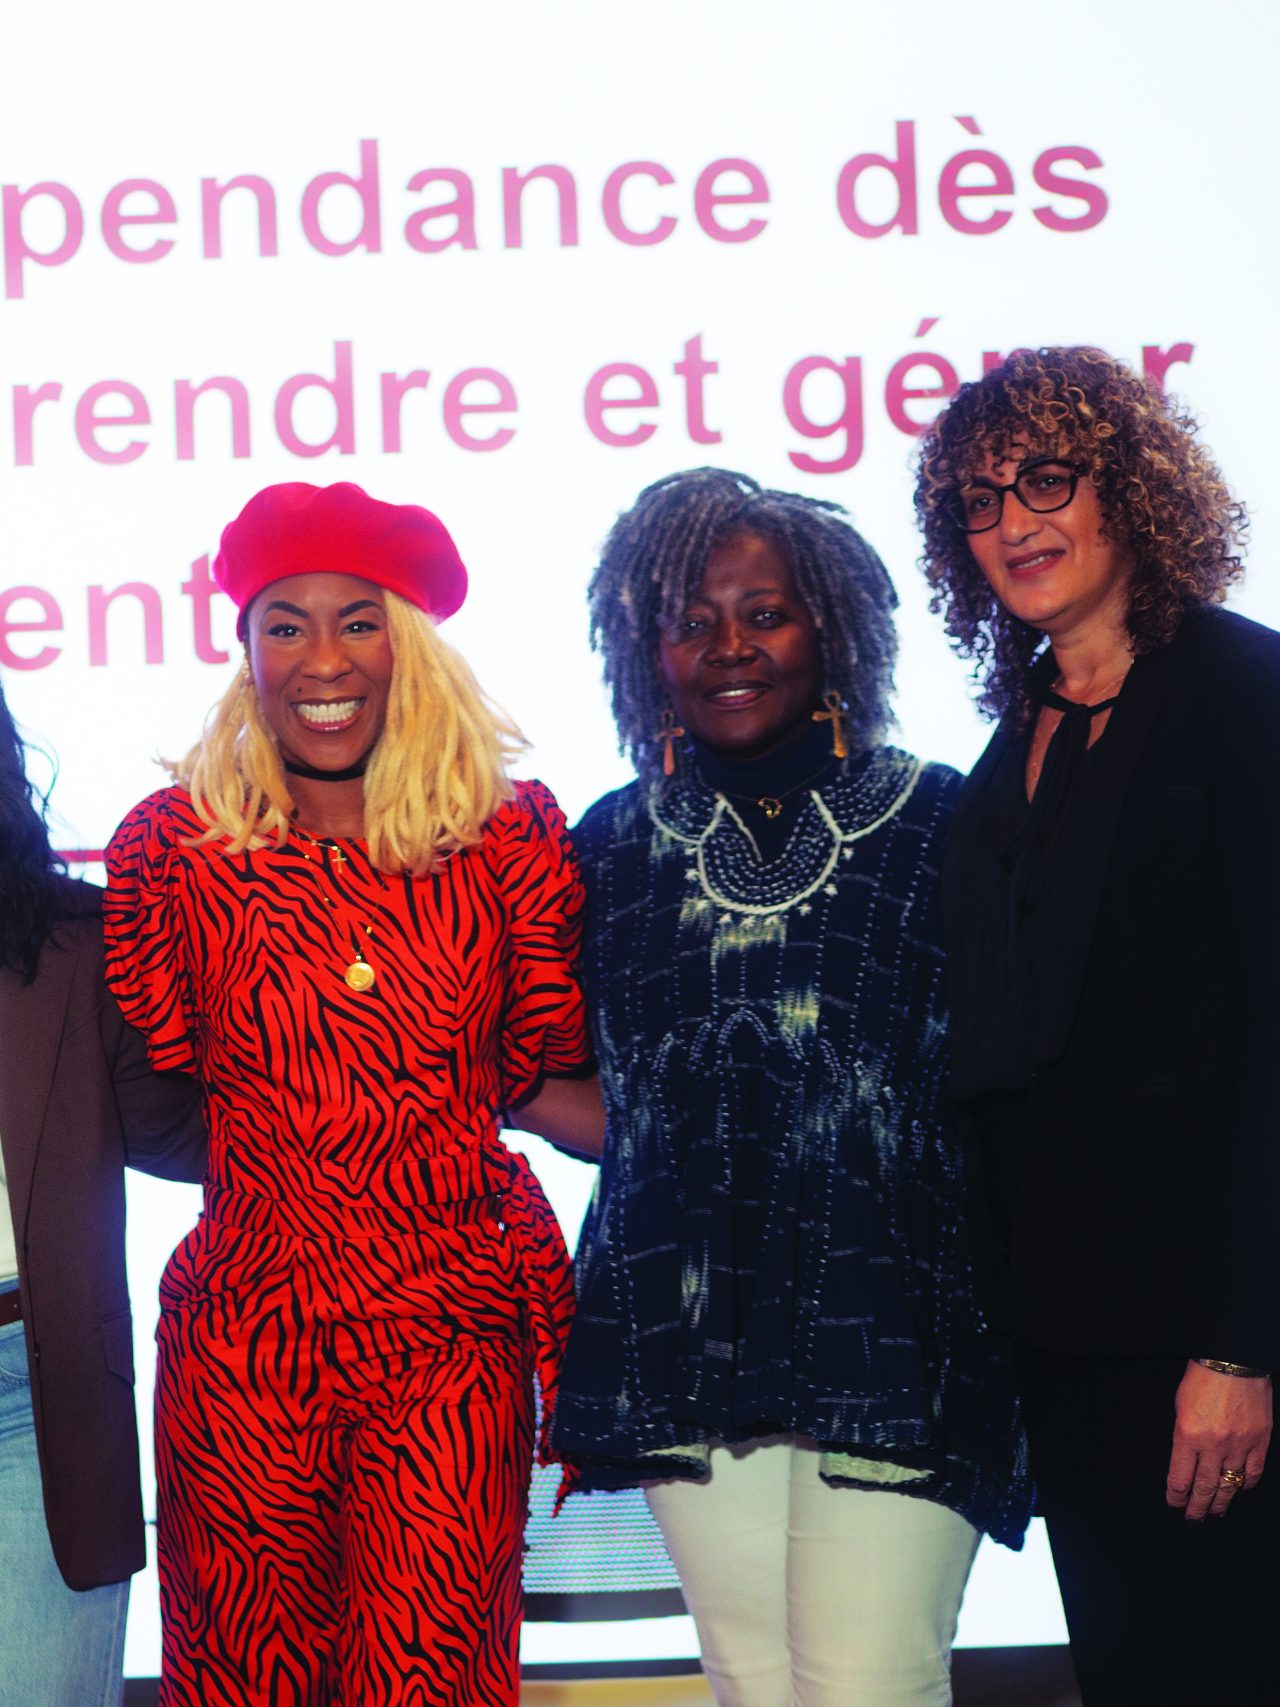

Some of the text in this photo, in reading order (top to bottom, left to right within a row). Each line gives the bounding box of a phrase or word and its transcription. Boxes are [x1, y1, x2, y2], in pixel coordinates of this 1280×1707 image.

[835, 115, 1110, 239] dès
[583, 333, 723, 448] et
[782, 317, 1195, 475] gér
